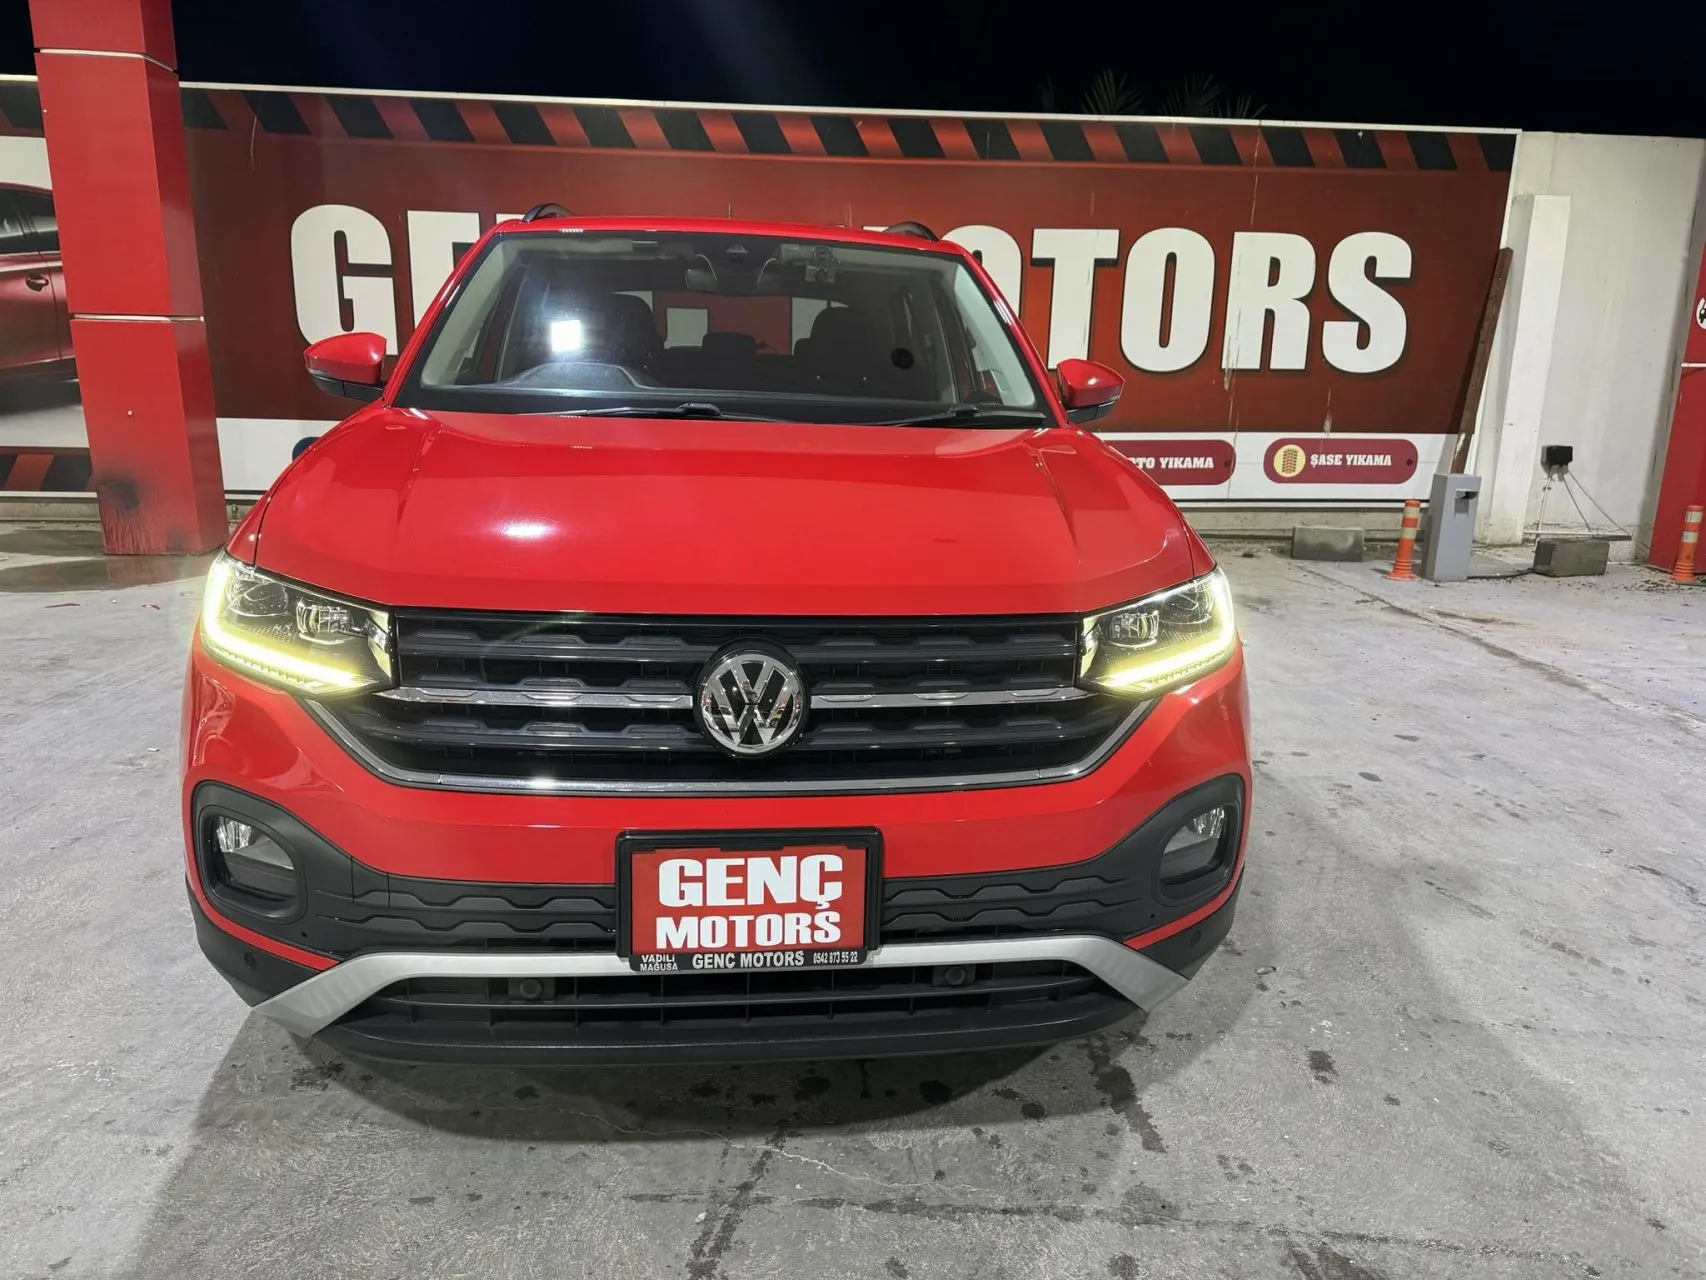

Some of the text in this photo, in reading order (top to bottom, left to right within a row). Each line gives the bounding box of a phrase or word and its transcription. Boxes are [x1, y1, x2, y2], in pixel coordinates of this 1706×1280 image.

[291, 204, 1412, 374] GE TORS
[1159, 457, 1214, 469] YIKAMA
[1310, 454, 1392, 468] ŞASE YIKAMA
[658, 854, 843, 910] GENÇ
[656, 911, 841, 950] MOTORS
[740, 950, 805, 968] MOTORS
